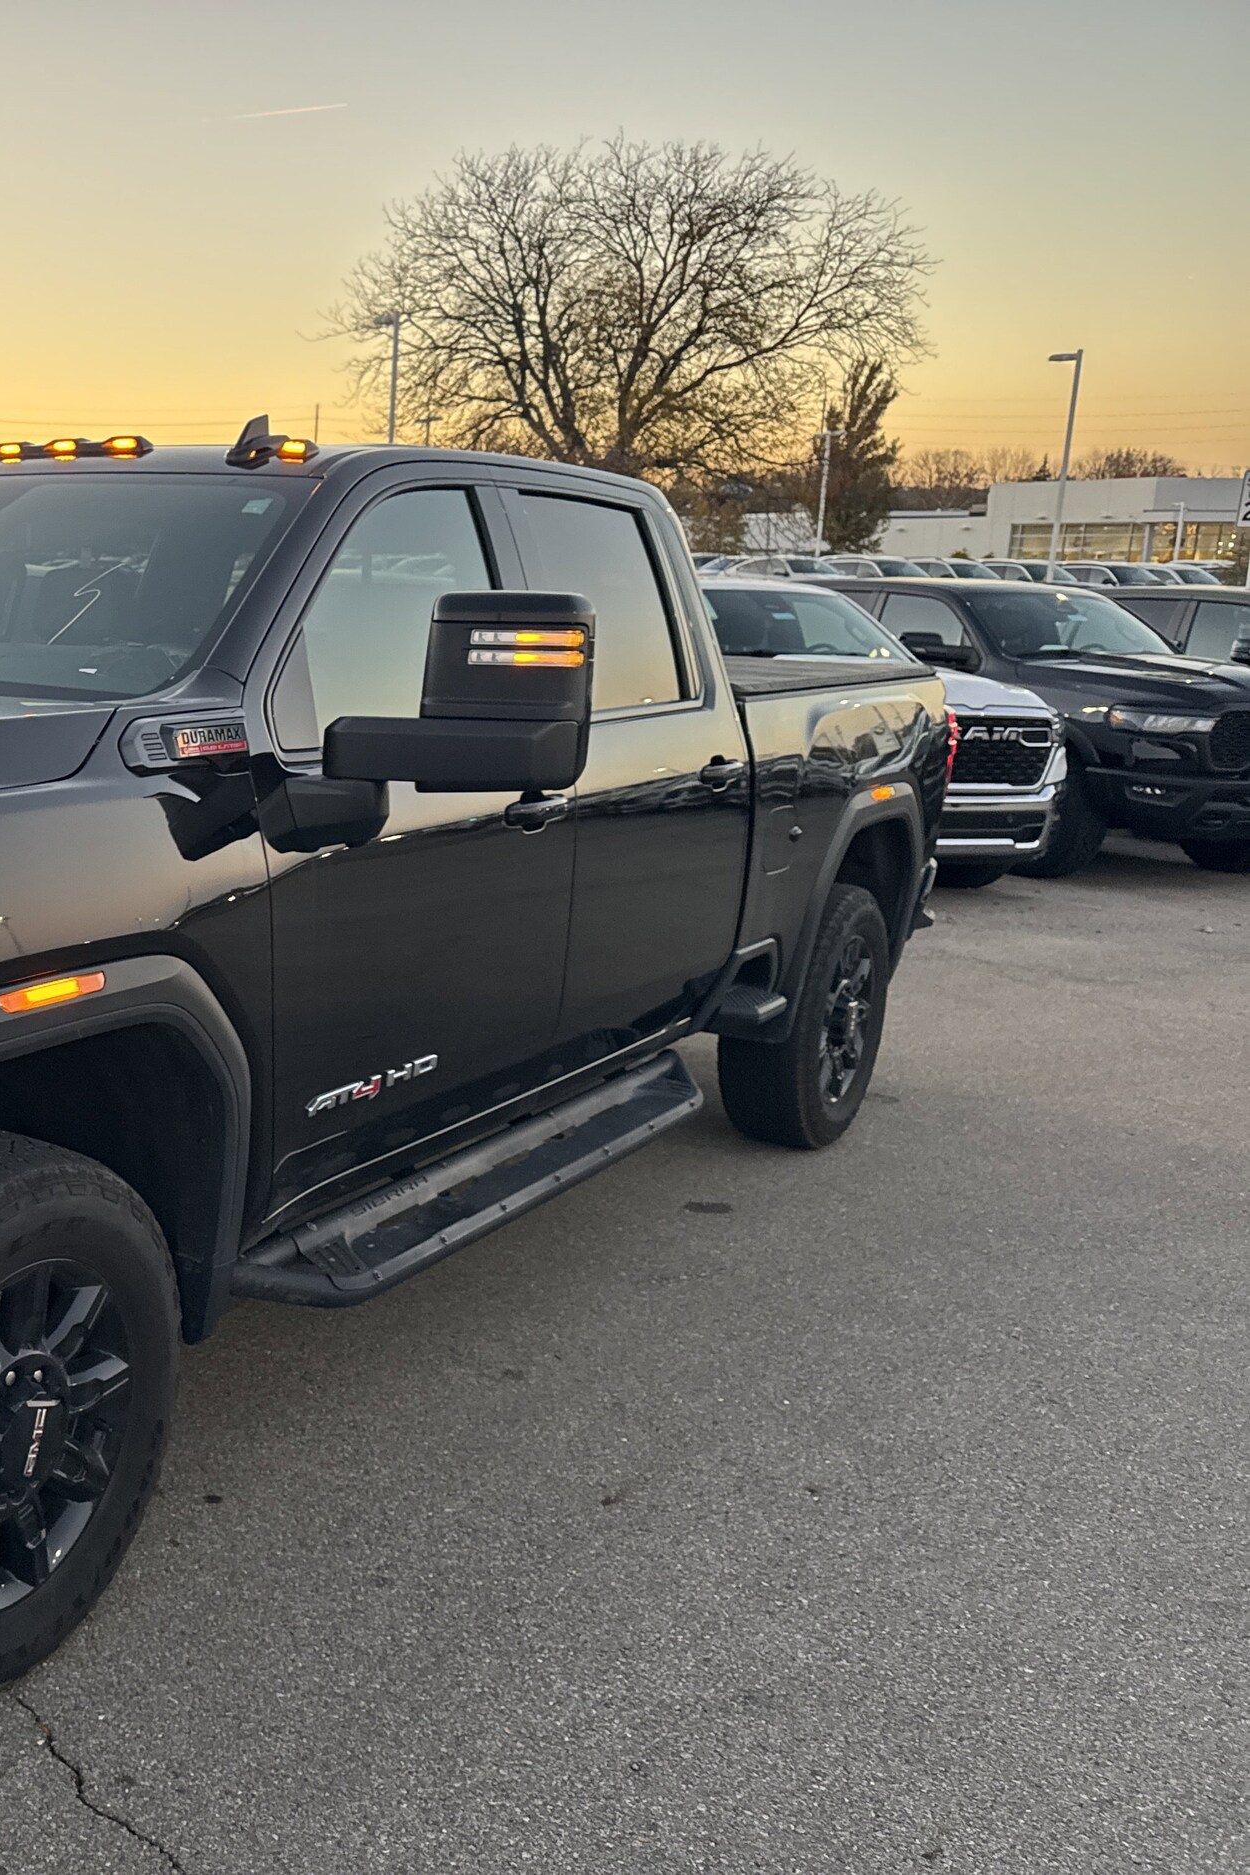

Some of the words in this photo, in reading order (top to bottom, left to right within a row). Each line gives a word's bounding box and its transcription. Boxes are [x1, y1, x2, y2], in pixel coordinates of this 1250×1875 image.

[181, 727, 241, 745] DURAMAX
[957, 726, 1018, 741] AM
[305, 1074, 382, 1117] AT4
[386, 1054, 438, 1087] HD
[352, 1175, 429, 1217] SIERRA
[23, 1408, 47, 1477] GMC
